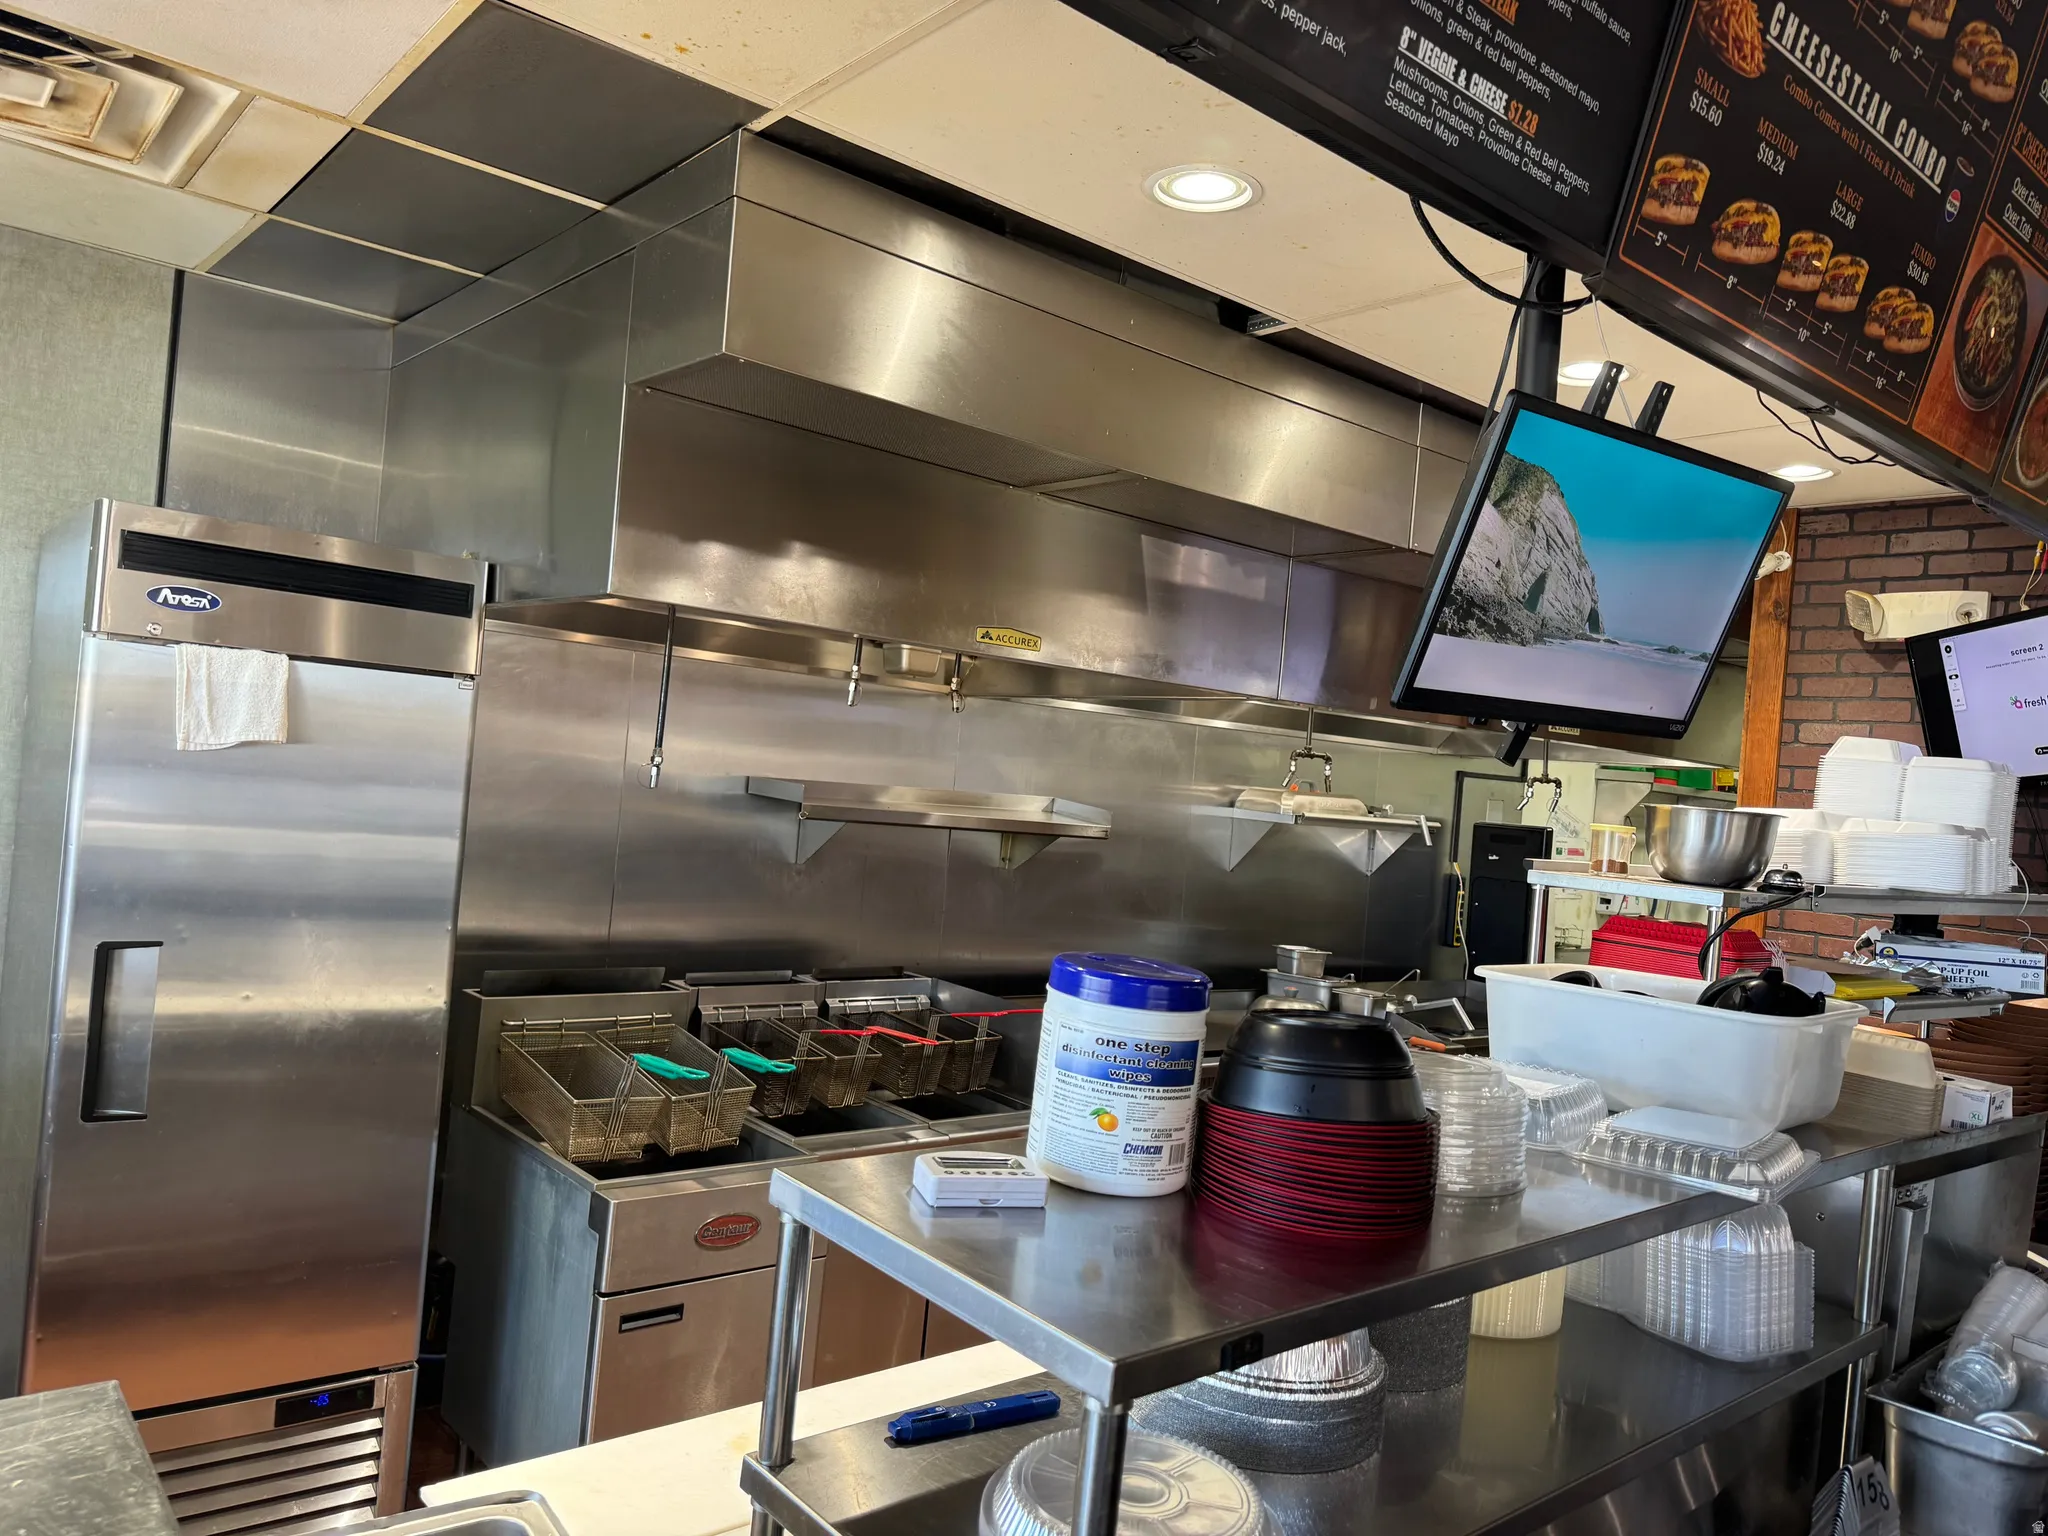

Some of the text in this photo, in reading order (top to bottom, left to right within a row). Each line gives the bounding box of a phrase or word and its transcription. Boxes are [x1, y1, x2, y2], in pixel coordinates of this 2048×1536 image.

[1483, 0, 1519, 22] EAK
[1281, 4, 1321, 37] pepper
[1322, 26, 1347, 57] jack,
[1608, 17, 1632, 47] sauce,
[1446, 18, 1478, 46] green
[1474, 36, 1482, 52] &
[1484, 44, 1500, 62] red
[1500, 53, 1516, 75] bell
[1516, 68, 1551, 102] peppers,
[1465, 5, 1492, 38] Steak,
[1494, 29, 1538, 71] provolone,
[1540, 61, 1578, 97] seasoned
[1578, 88, 1600, 116] mayo,
[1400, 25, 1540, 134] 8" VEGGIE & CHEESE $7.28
[1694, 67, 1731, 108] SMALL
[1769, 1, 1947, 186] CHEESESTEAK COMBO
[1385, 91, 1459, 147] Seasoned Mayo
[1690, 89, 1722, 127] $15.60
[1389, 73, 1571, 197] Lettuce, Tomatoes, Provolone Cheese, and
[1394, 56, 1591, 195] Mushrooms, Onions, Green & Red Bell Peppers,
[1757, 116, 1799, 160] MEDIUM
[1783, 74, 1813, 110] Combo
[1813, 100, 1841, 134] Comes
[1841, 126, 1859, 151] with
[1860, 139, 1865, 155] 1
[1864, 143, 1883, 172] Fries
[1883, 160, 1891, 177] &
[1894, 170, 1916, 199] Drink
[1757, 141, 1785, 175] $19.24
[1836, 180, 1864, 212] LARGE
[2014, 177, 2043, 216] Over Fries
[1830, 198, 1857, 230] $22.88
[2004, 203, 2020, 225] Over
[2019, 216, 2032, 239] Tots
[1655, 231, 1668, 246] 5"
[1910, 242, 1936, 270] JUMBO
[1726, 275, 1738, 289] 8"
[1907, 259, 1930, 286] $30.16
[1785, 299, 1832, 335] 5" 5"
[1798, 328, 1811, 343] 10"
[1866, 350, 1876, 362] 8"
[1875, 376, 1886, 389] 16"
[157, 588, 210, 609] ATOSA
[995, 634, 1039, 648] ACCUREX
[2010, 643, 2044, 656] screen 2
[2024, 696, 2046, 708] fresh
[1937, 967, 1989, 977] P-UP FOIL
[1946, 975, 1975, 984] HEETS
[1062, 1043, 1194, 1070] disinfectant cleaning
[1095, 1036, 1171, 1057] one step
[1058, 1070, 1080, 1082] CLEANS,
[1080, 1077, 1116, 1090] SANITIZES,
[1117, 1085, 1155, 1094] DISINFECTS
[1109, 1069, 1152, 1082] wipes
[1091, 1088, 1141, 1100] BACTERICIDAL
[1971, 1113, 1982, 1121] XL
